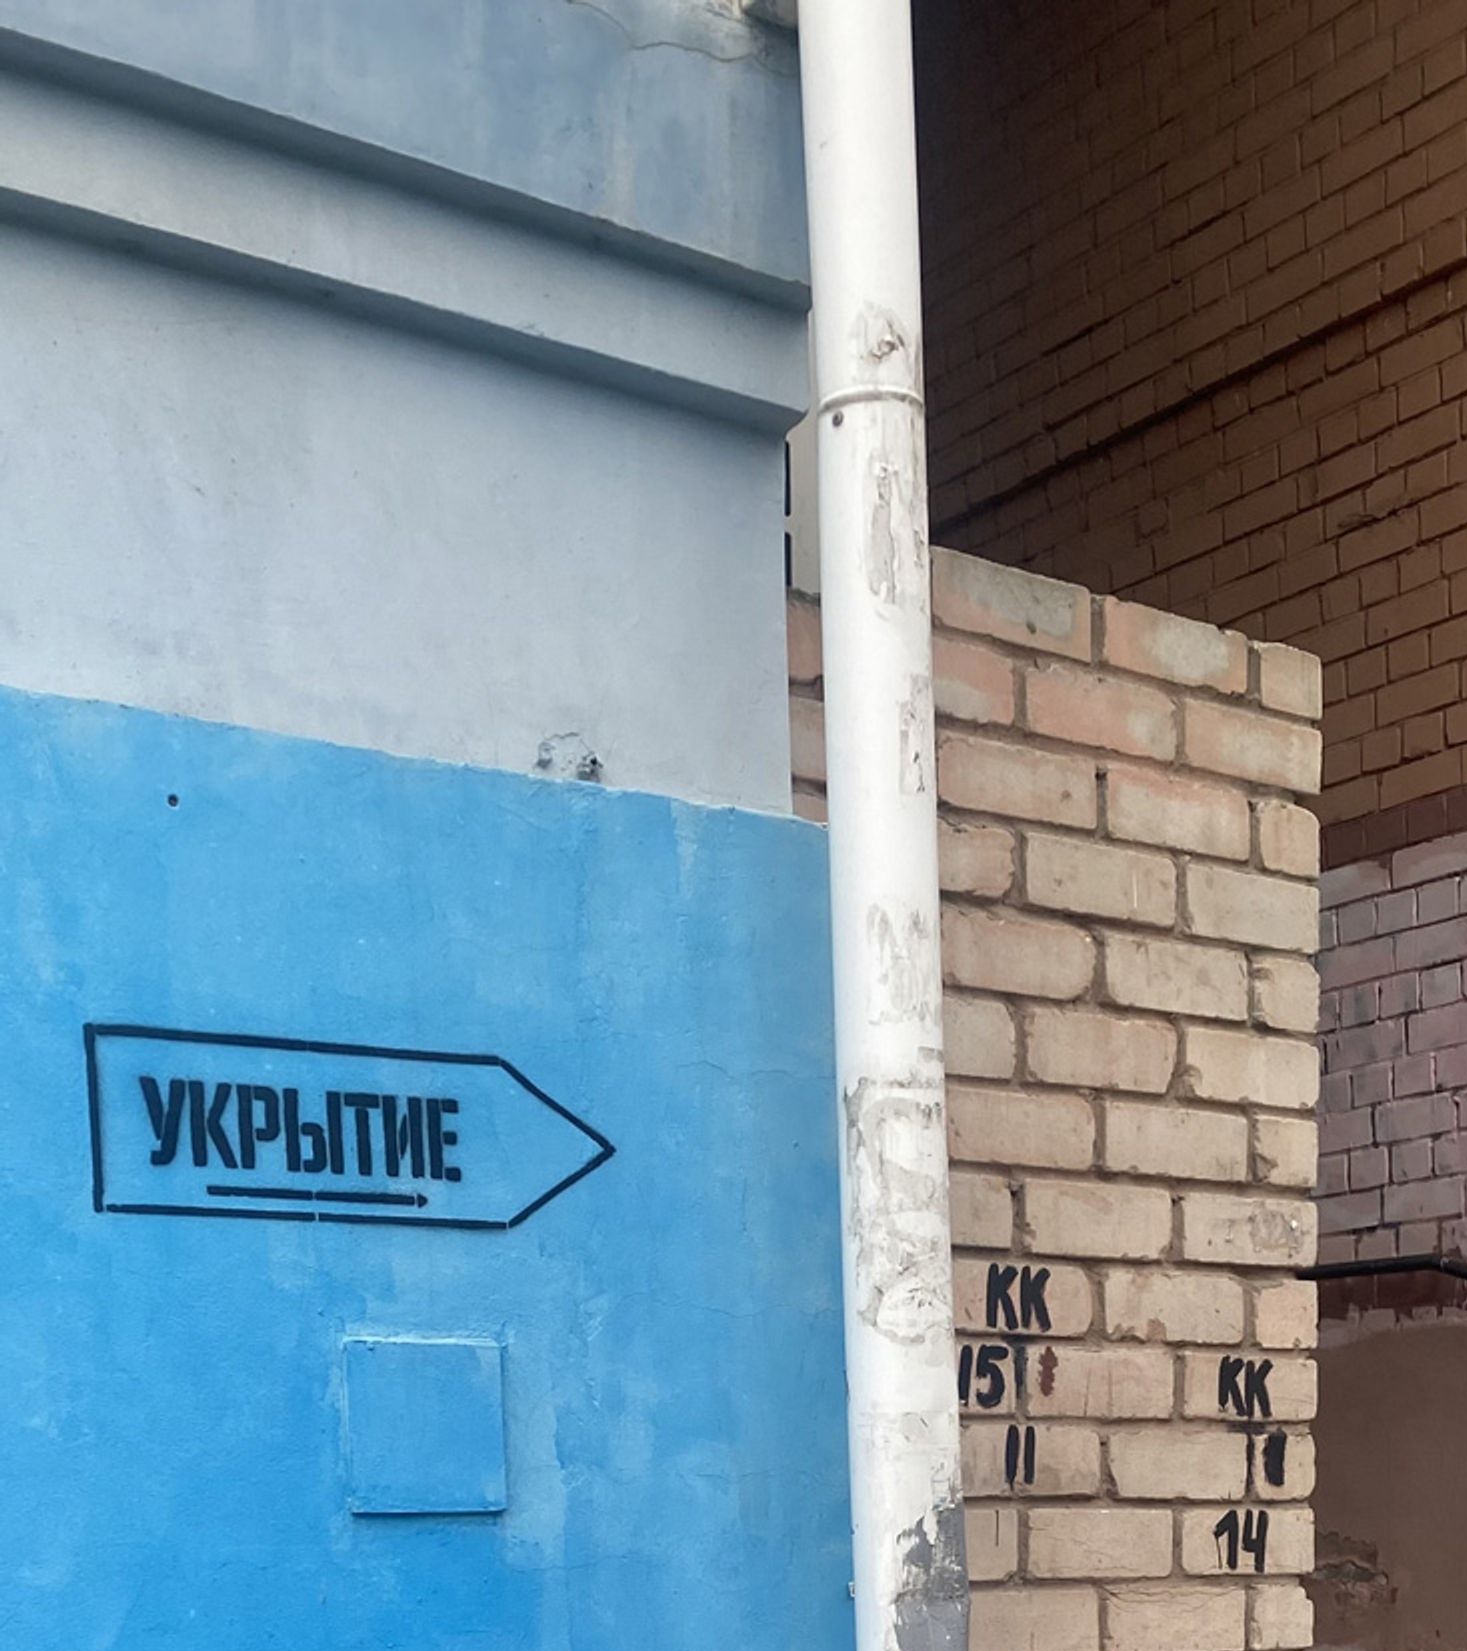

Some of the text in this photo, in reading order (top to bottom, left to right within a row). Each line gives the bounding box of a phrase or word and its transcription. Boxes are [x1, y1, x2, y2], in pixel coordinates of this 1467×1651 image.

[138, 1076, 463, 1182] УКРЫТИЕ
[958, 1344, 1010, 1409] 15
[1214, 1509, 1269, 1574] 14
